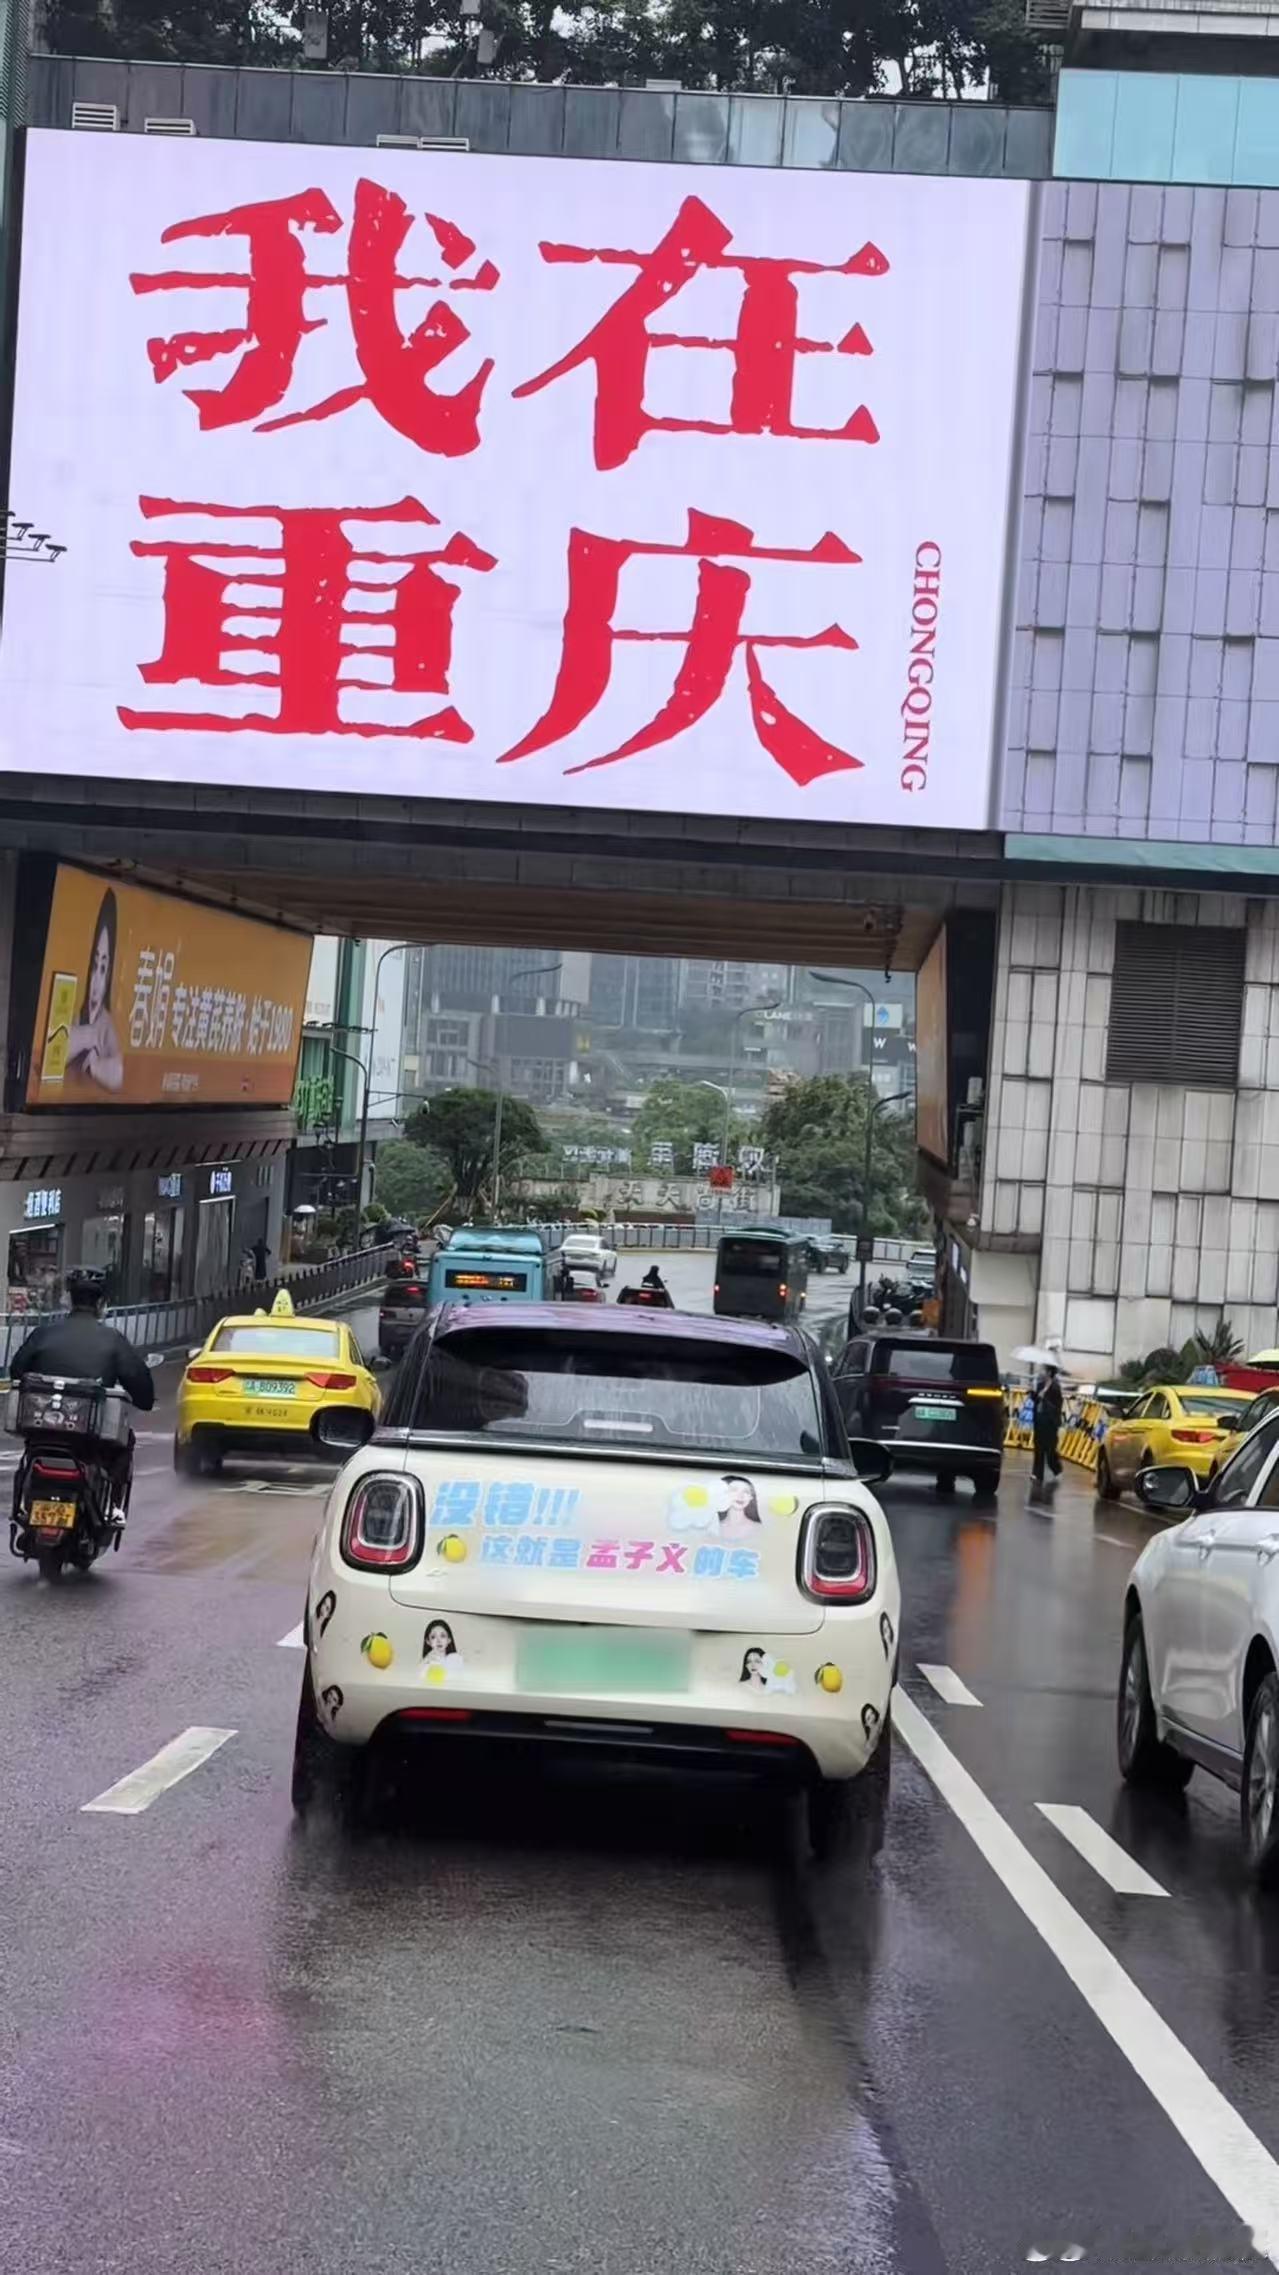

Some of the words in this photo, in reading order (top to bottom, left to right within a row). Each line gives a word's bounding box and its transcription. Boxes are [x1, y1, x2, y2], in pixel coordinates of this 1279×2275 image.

[130, 178, 890, 471] 我在
[116, 495, 863, 786] 重庆
[900, 540, 941, 792] CHONGQING
